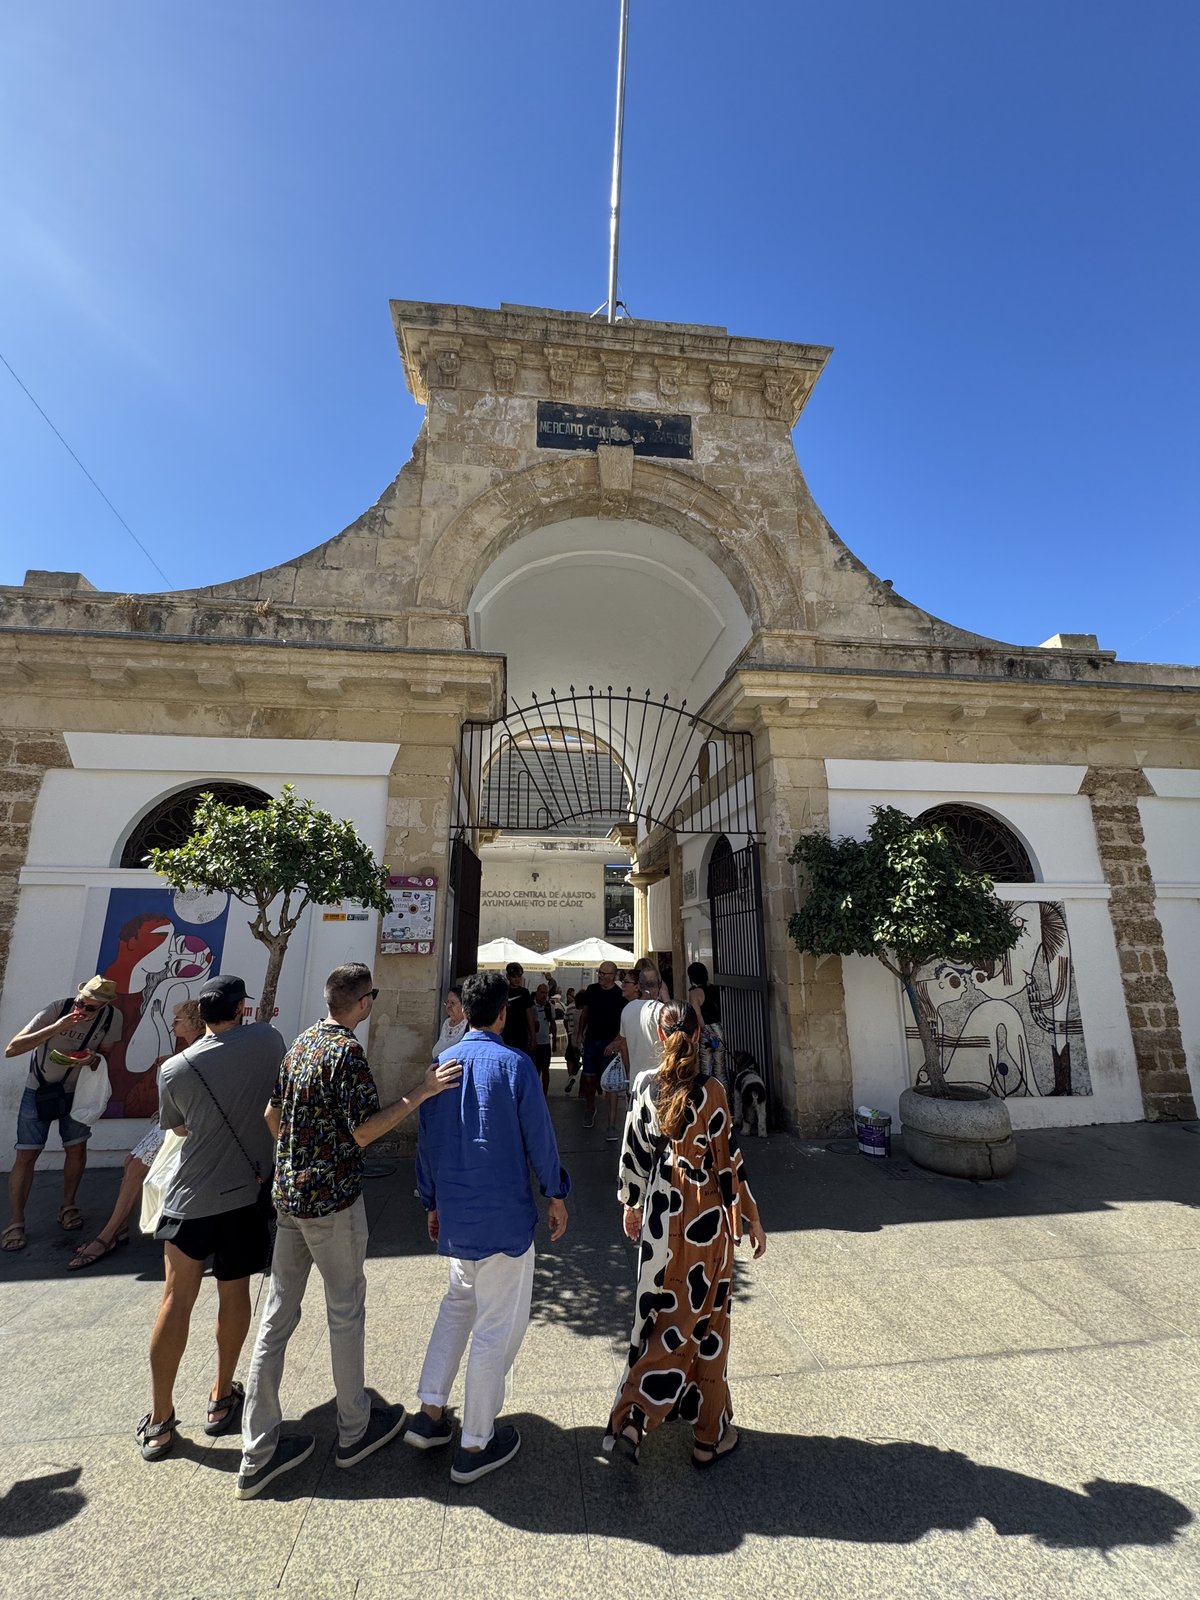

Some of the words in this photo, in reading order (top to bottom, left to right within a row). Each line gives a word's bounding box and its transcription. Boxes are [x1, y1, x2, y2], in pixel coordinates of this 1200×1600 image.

[539, 420, 583, 436] MERCADO
[513, 890, 547, 898] CENTRAL
[561, 891, 596, 899] ABASTOS
[482, 899, 545, 907] AYUNTAMIENTO
[559, 898, 584, 907] CÁDIZ
[60, 1030, 98, 1041] GUES
